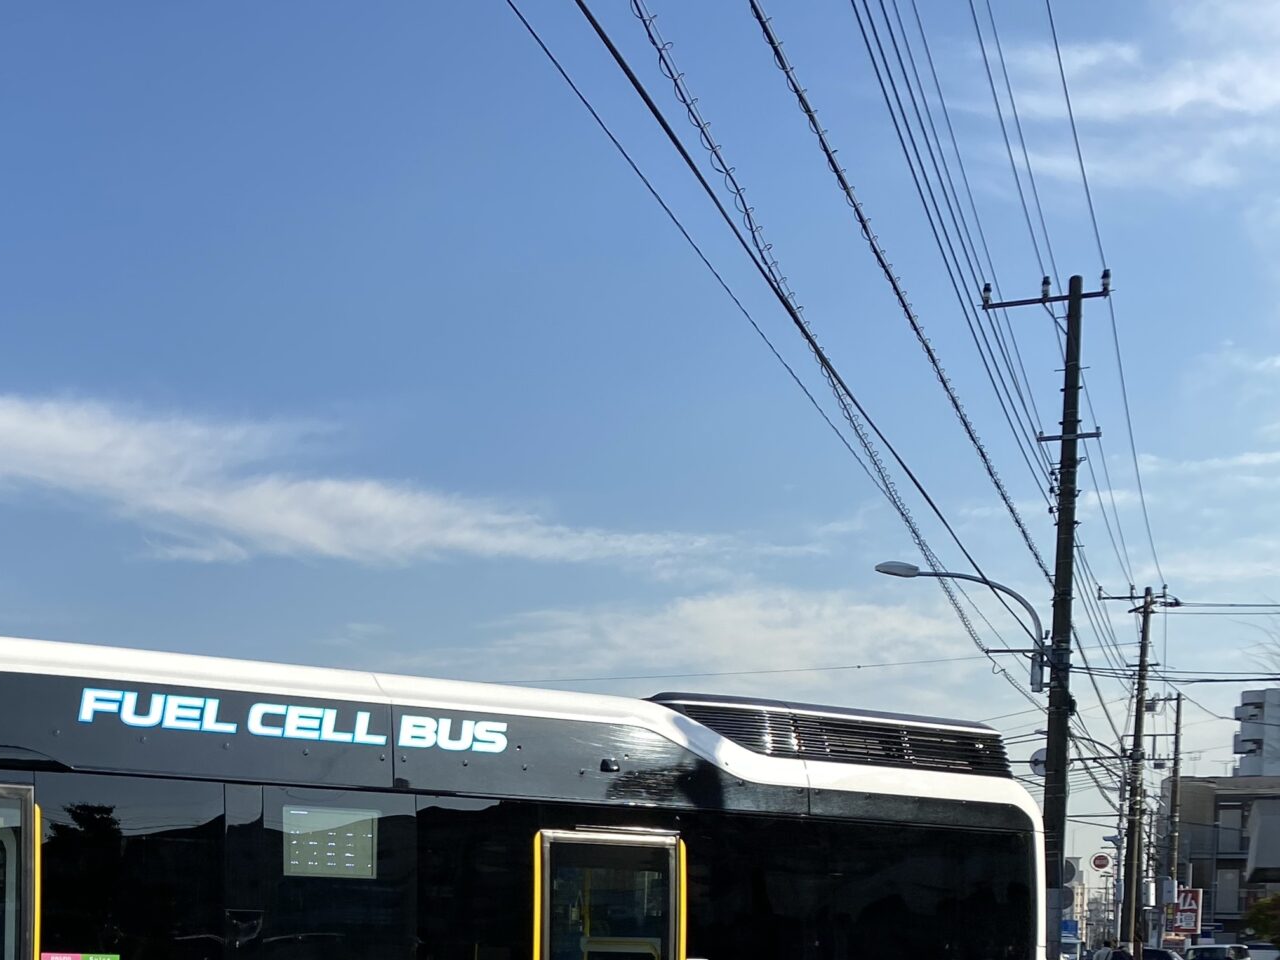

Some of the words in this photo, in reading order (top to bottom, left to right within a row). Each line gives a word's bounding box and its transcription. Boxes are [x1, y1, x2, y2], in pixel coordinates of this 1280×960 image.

[77, 687, 237, 734] FUEL
[247, 702, 387, 746] CELL
[398, 714, 508, 753] BUS
